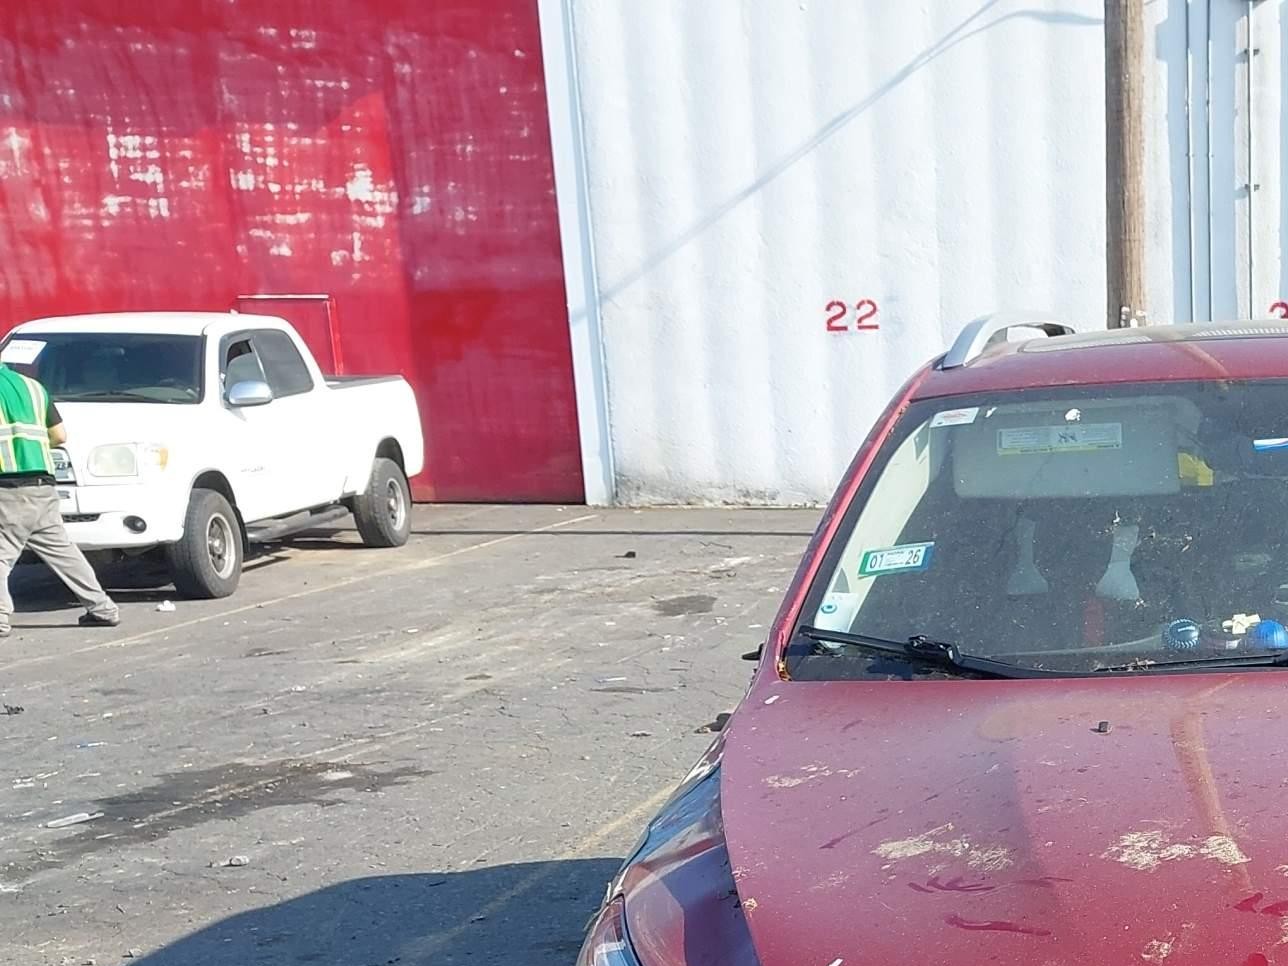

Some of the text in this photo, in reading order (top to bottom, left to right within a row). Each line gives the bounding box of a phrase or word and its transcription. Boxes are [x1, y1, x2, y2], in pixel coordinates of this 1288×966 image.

[825, 300, 879, 332] 22
[869, 548, 921, 569] 01 26
